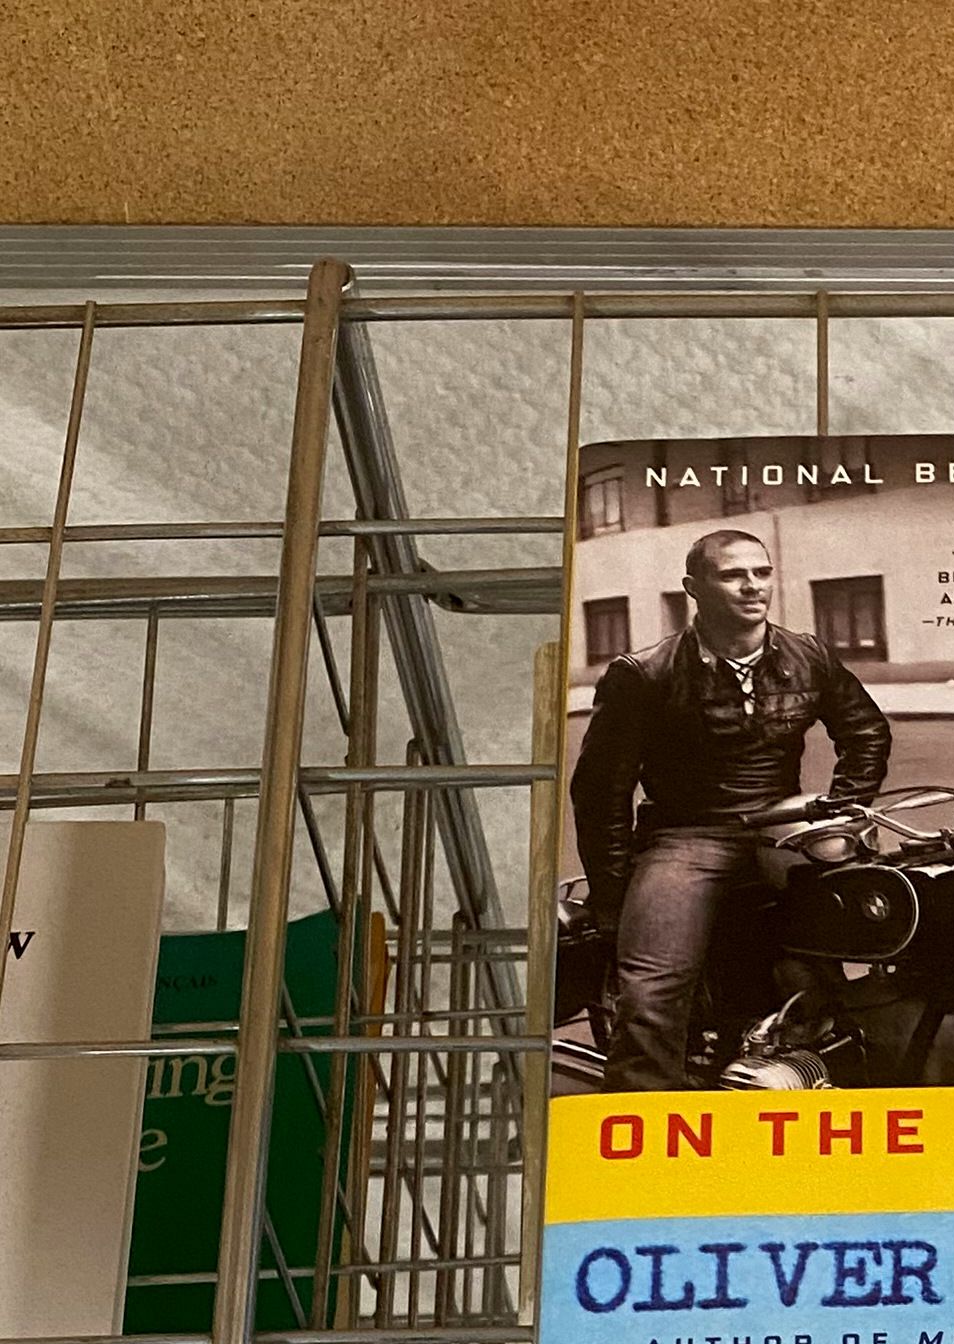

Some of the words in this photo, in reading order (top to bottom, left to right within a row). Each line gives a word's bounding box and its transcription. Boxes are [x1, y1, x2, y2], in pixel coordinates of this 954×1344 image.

[646, 464, 884, 487] NATIONAL
[599, 1112, 713, 1160] ON
[758, 1109, 925, 1157] THE
[575, 1238, 943, 1314] OLIVER
